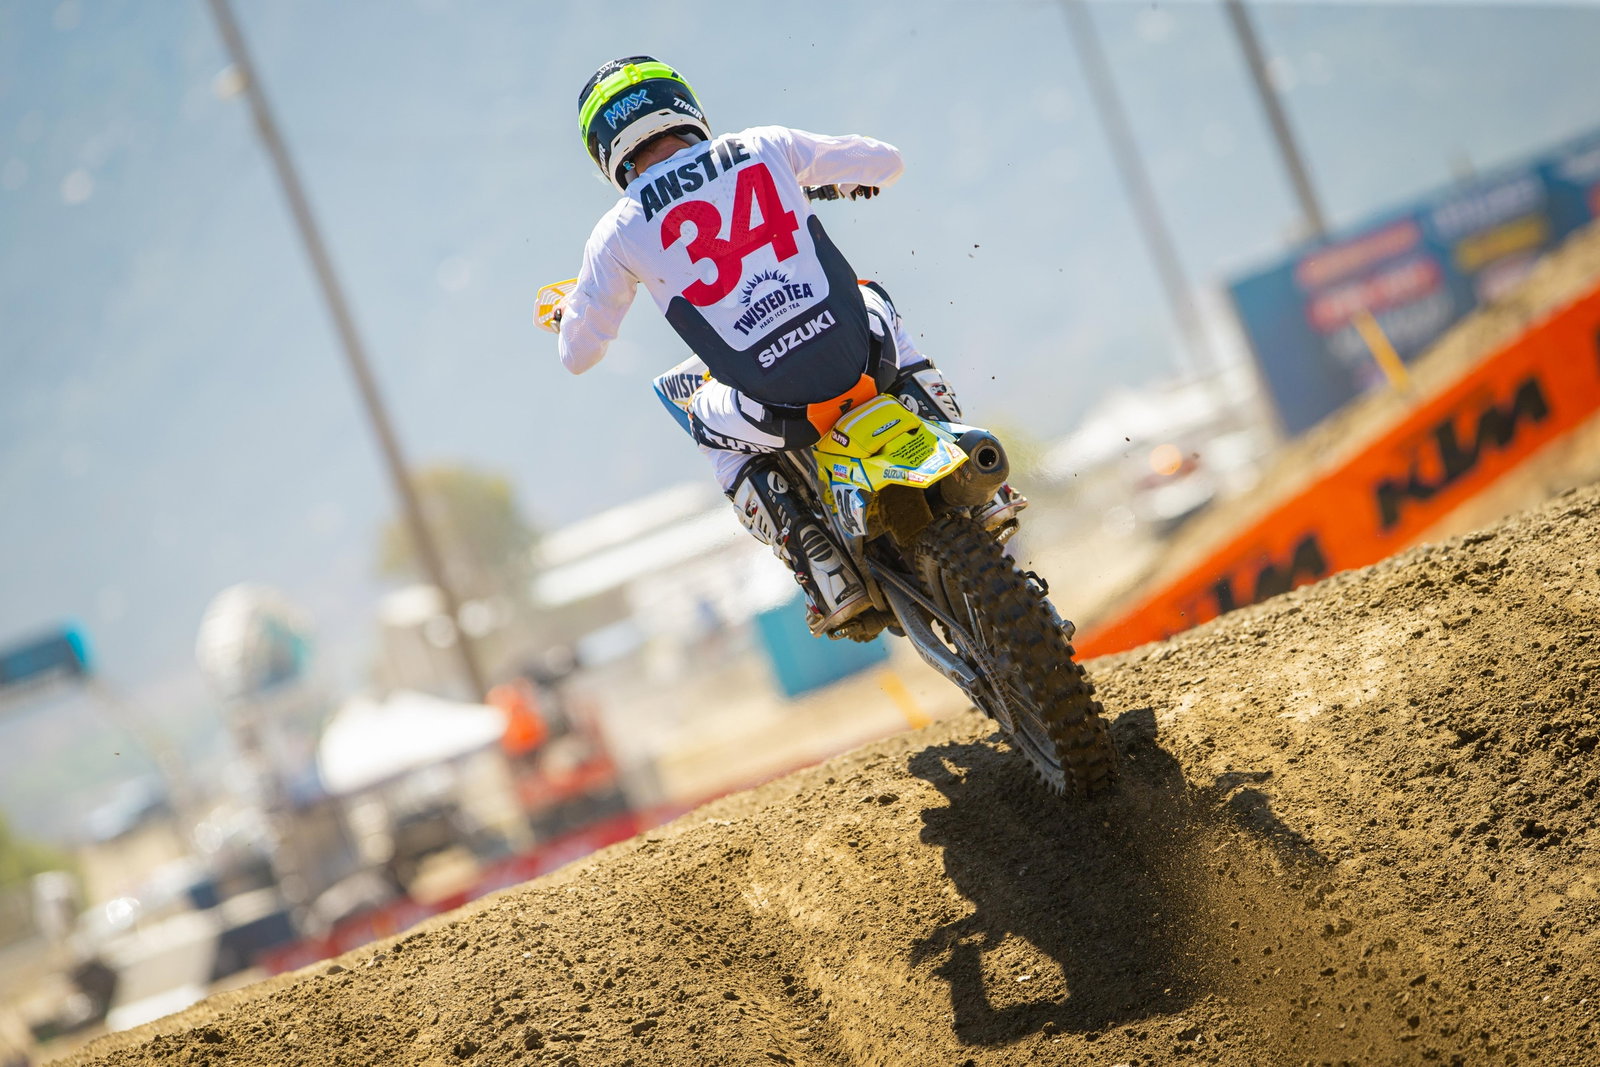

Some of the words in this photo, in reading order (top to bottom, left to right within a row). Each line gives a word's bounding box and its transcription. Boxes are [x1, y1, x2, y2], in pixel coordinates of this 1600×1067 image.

[603, 89, 653, 130] MAX
[673, 97, 704, 121] THOR
[640, 138, 751, 223] ANSTIE
[660, 162, 800, 307] 34
[733, 290, 787, 336] TWISTED
[783, 282, 814, 301] TEA
[759, 316, 775, 330] HARD
[774, 308, 788, 319] ICED
[788, 302, 801, 311] TEA
[758, 309, 837, 369] SUZUKI
